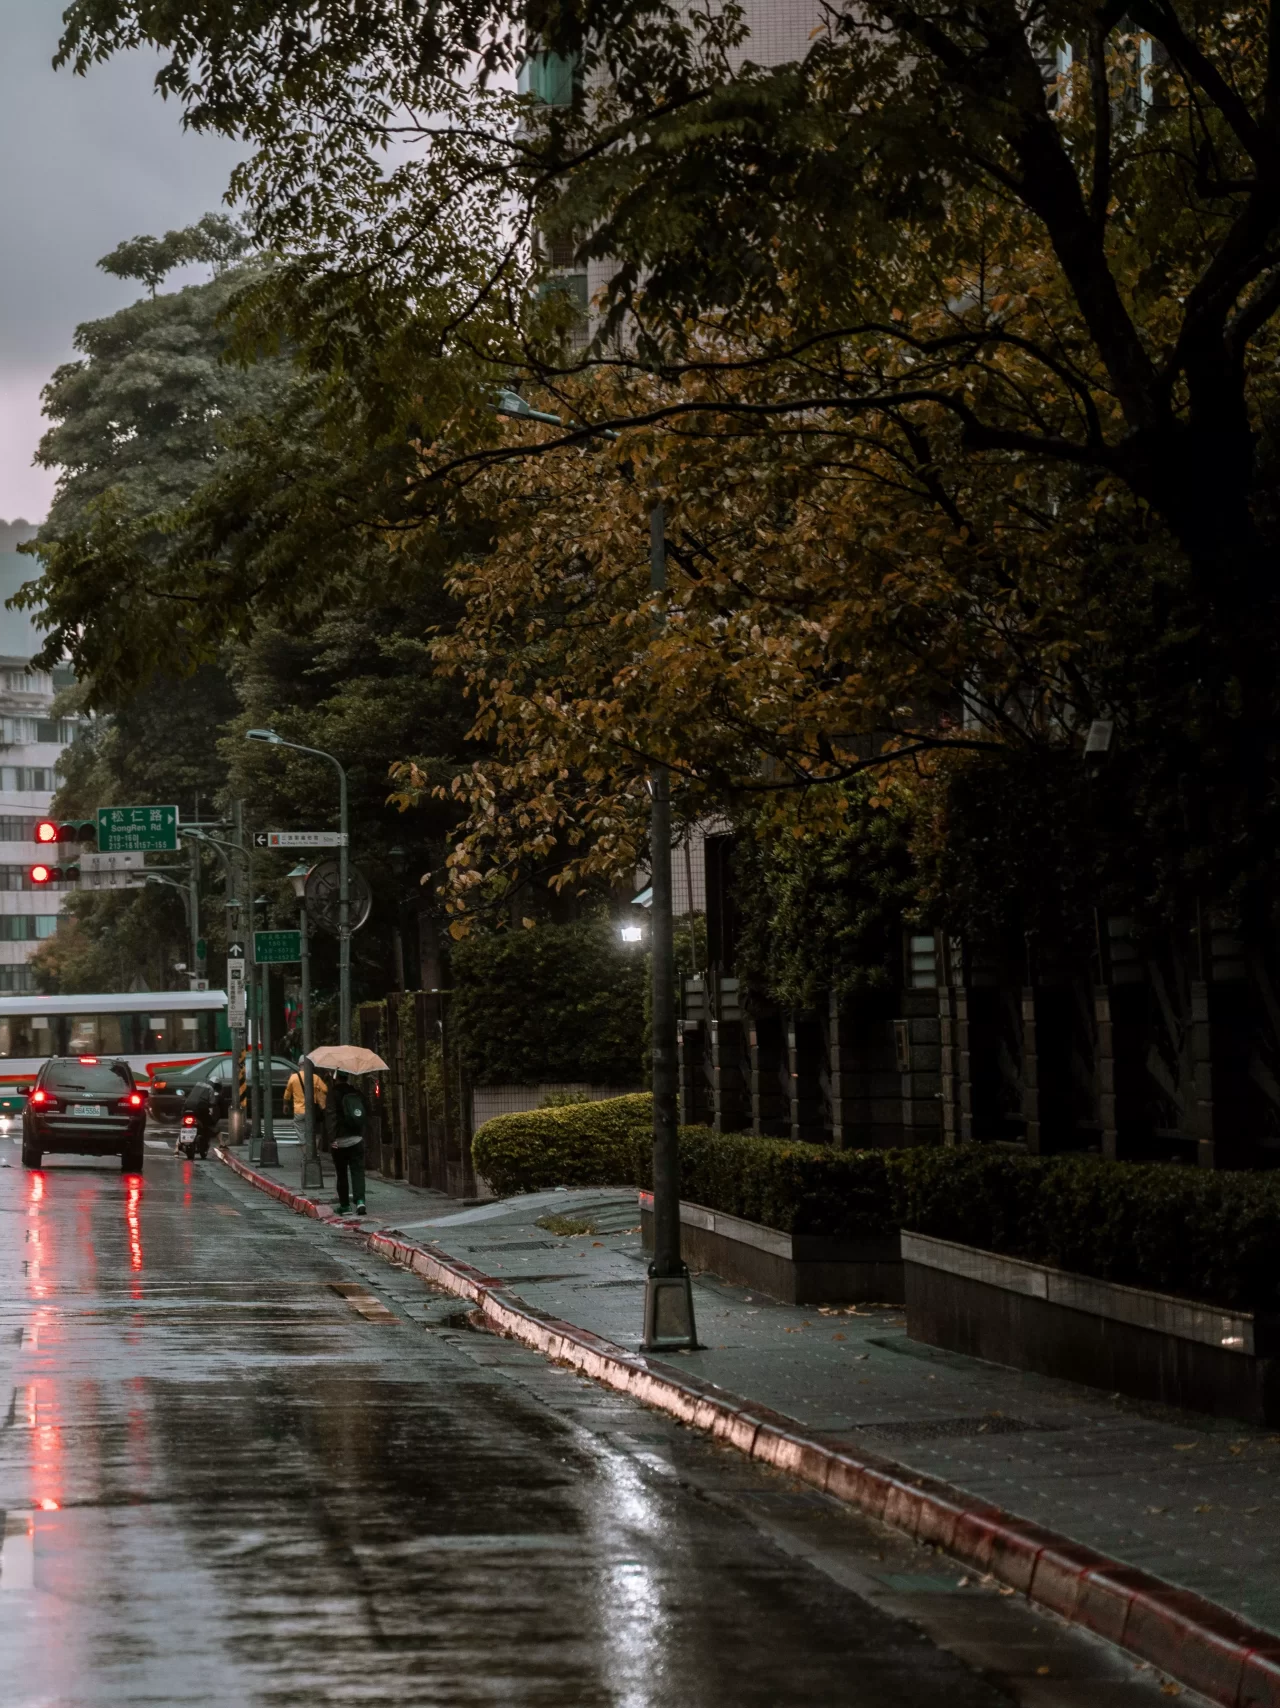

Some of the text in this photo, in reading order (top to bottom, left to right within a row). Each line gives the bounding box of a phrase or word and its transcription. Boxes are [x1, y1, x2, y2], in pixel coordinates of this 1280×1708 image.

[111, 809, 162, 823] 松仁路
[111, 824, 146, 834] SongRen
